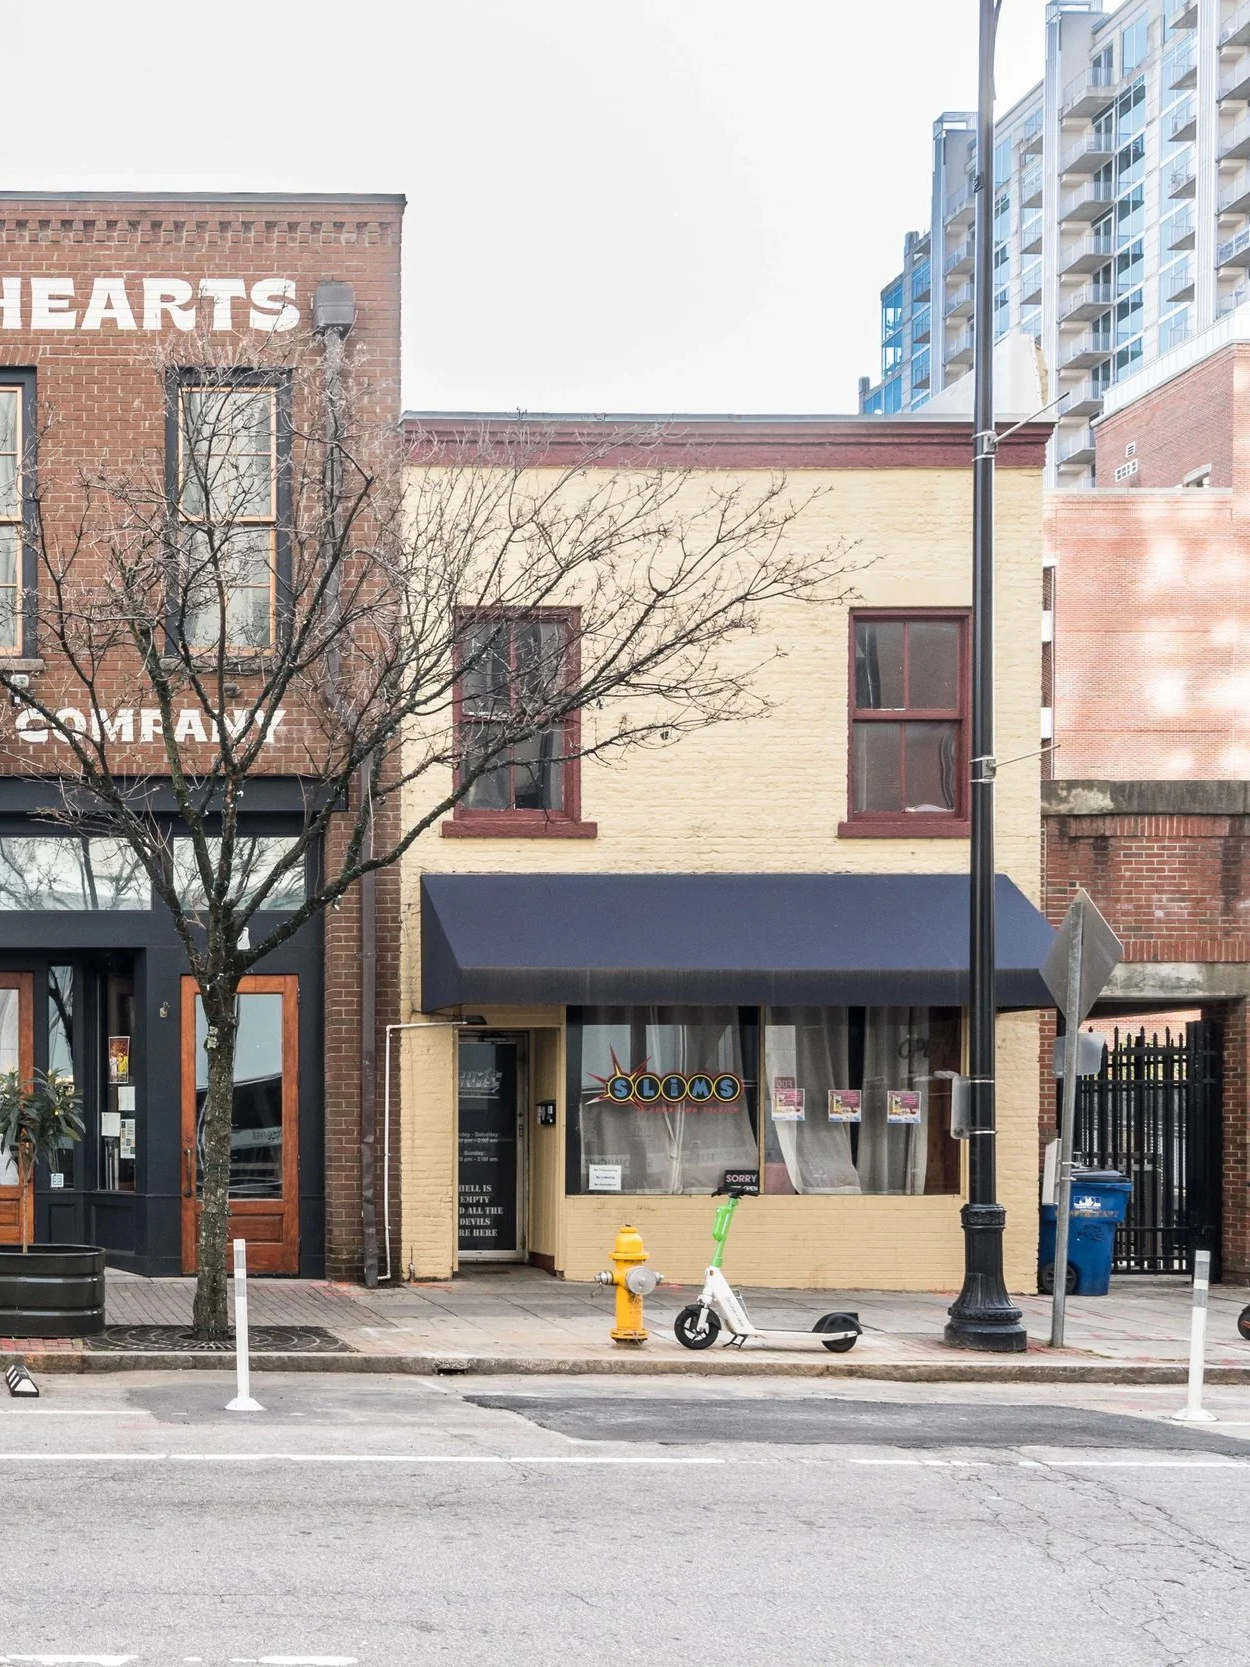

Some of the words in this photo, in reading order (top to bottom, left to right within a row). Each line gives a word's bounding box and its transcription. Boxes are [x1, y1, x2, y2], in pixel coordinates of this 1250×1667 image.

[14, 708, 285, 744] COMPANY
[725, 1174, 758, 1183] SORRY
[459, 1184, 482, 1192] HELL
[483, 1184, 492, 1192] IS
[460, 1196, 490, 1204] EMPTY
[466, 1207, 484, 1215] ALL
[485, 1207, 504, 1215] THE
[459, 1218, 491, 1226] DEVILS
[459, 1229, 471, 1237] RE
[473, 1229, 498, 1237] HERE
